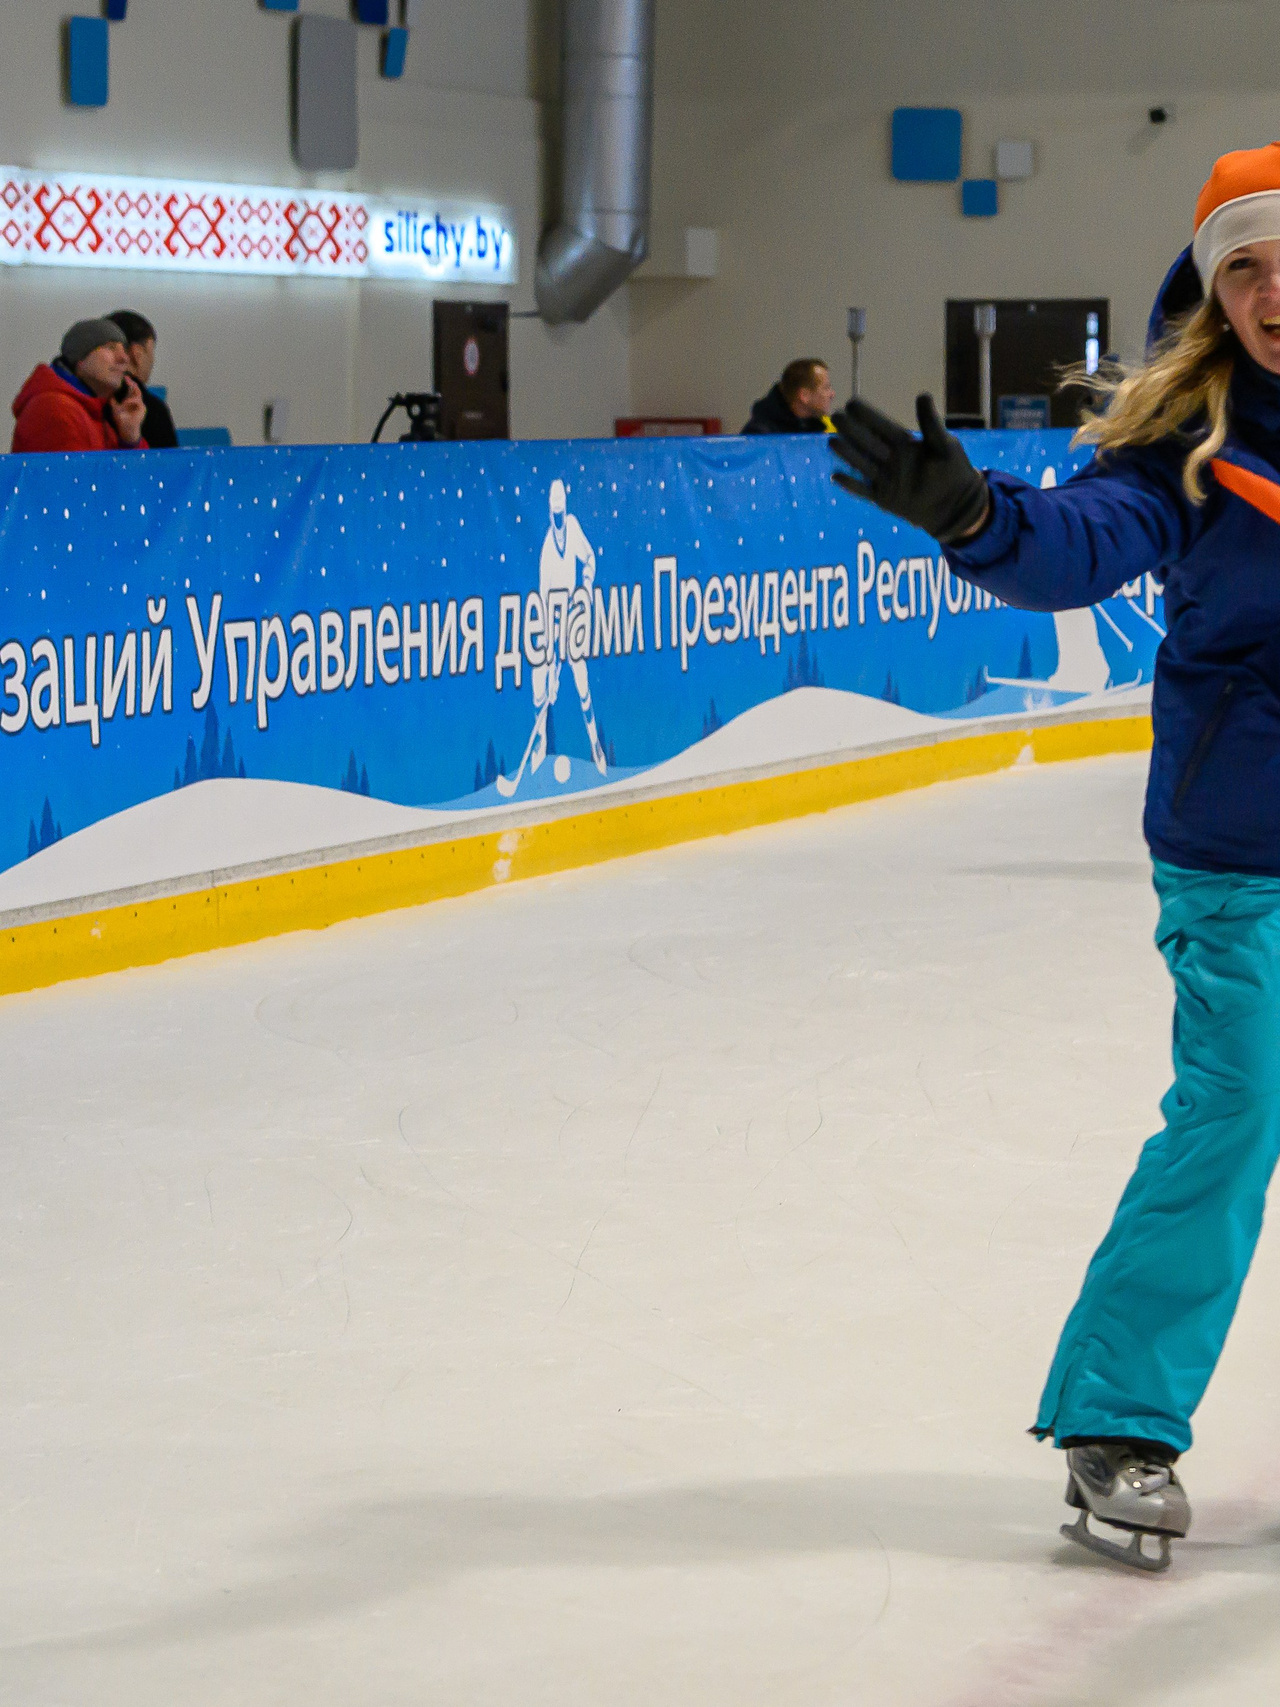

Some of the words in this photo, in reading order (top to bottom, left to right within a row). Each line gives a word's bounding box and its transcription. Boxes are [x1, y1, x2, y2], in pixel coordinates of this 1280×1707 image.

[384, 210, 505, 270] silichy.by
[0, 597, 173, 746] заций
[186, 594, 484, 729] Управления
[495, 585, 645, 691] делами
[653, 556, 849, 671] Президента
[857, 540, 1007, 641] Респуб
